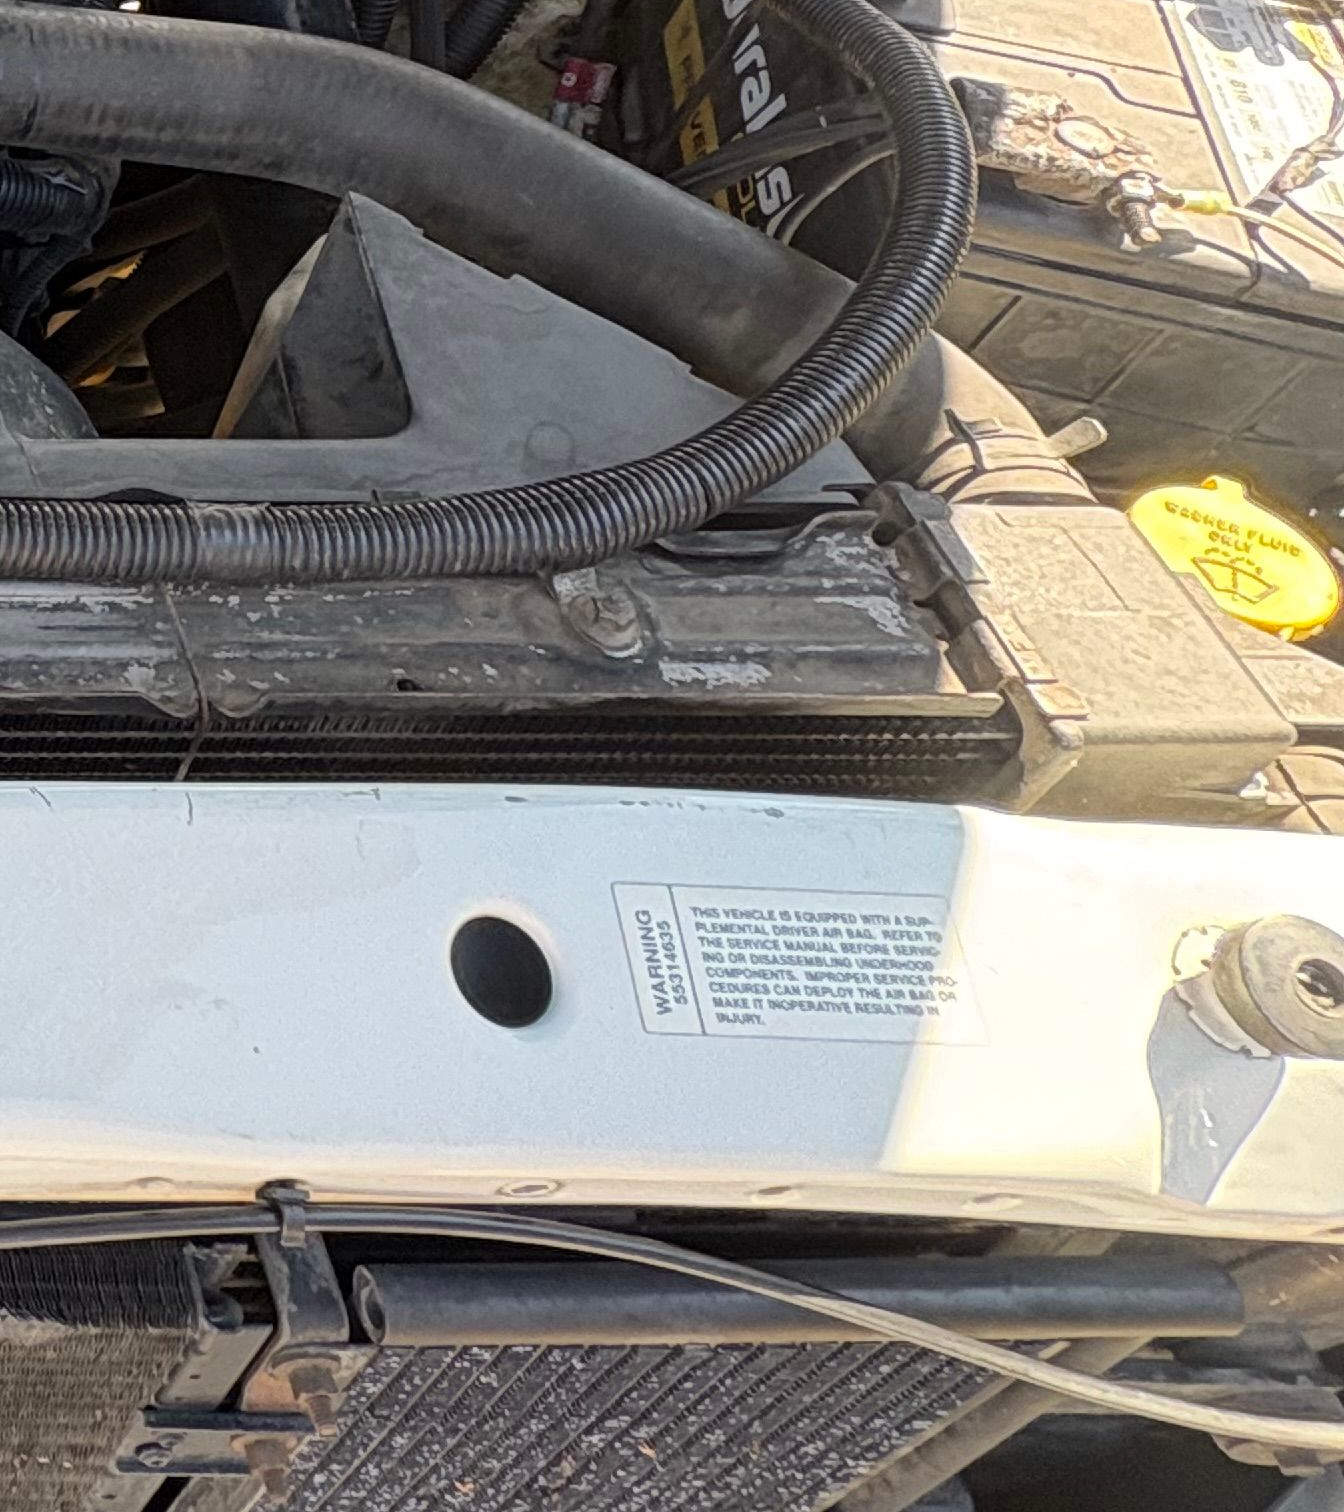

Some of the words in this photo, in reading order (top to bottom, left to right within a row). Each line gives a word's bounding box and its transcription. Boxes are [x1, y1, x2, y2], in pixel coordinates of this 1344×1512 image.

[1164, 500, 1240, 536] WASHER
[1246, 529, 1301, 557] FLUID
[1208, 530, 1253, 554] ONLY
[689, 907, 721, 919] THIS
[722, 908, 776, 921] VEHICLE
[779, 911, 792, 921] IS
[794, 911, 857, 924] EQUIPPED
[859, 914, 891, 925] WITH
[893, 915, 902, 925] A
[694, 922, 769, 935] PLEMENTAL
[771, 925, 819, 937] DRIVER
[820, 927, 843, 938] AIR
[881, 929, 923, 941] REFER
[925, 931, 943, 942] TO
[697, 937, 723, 948] THE
[726, 938, 780, 950] SERVICE
[783, 940, 838, 953] MANUAL
[839, 942, 890, 955] BEFORE
[633, 909, 672, 1014] WARNING
[701, 952, 725, 963] ING
[727, 953, 746, 964] OR
[749, 954, 852, 968] DISASSEMBLING
[855, 958, 933, 971] UNDERHOOD
[804, 971, 871, 983] IMPROPER
[873, 973, 926, 985] SERVICE
[708, 982, 770, 994] CEDURES
[773, 985, 801, 995] CAN
[804, 986, 855, 998] DEPLOY
[857, 988, 882, 998] THE
[884, 988, 906, 999] AIR
[908, 990, 936, 1000] BAG
[937, 991, 956, 1001] OR
[712, 997, 750, 1009] MAKE
[752, 999, 764, 1009] IT
[767, 999, 851, 1012] INOPERATIVE
[854, 1002, 924, 1015] RESULTING
[926, 1005, 939, 1015] IN
